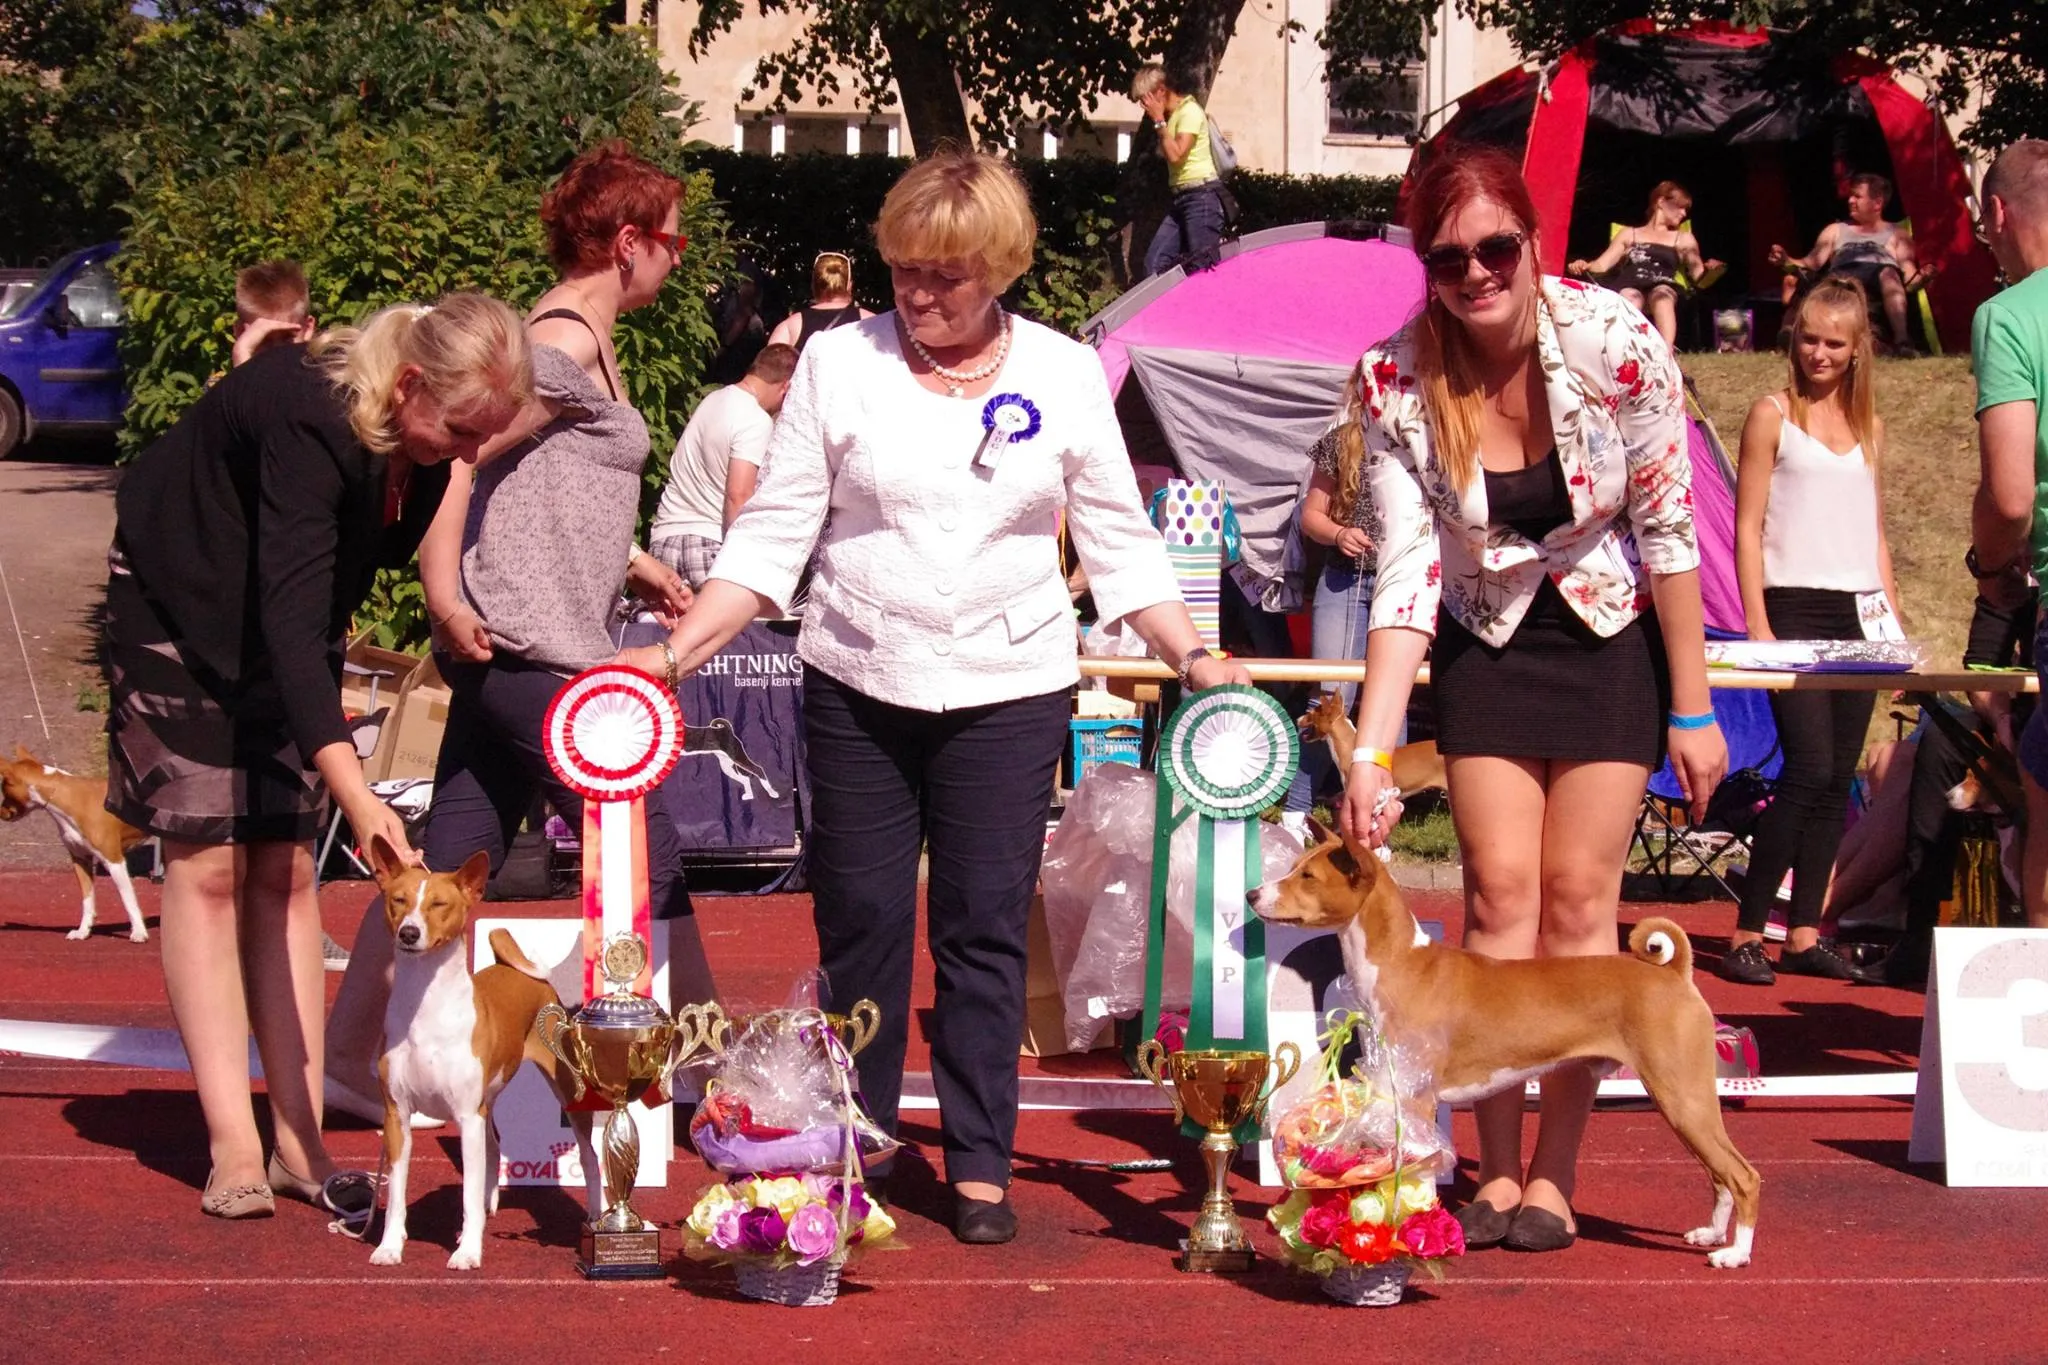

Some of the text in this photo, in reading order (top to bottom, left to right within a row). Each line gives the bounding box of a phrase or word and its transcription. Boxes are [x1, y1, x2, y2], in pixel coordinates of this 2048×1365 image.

[697, 654, 804, 676] GHTNING
[735, 675, 769, 689] basenji
[1955, 937, 2048, 1132] 3
[497, 1160, 562, 1179] ROYAL
